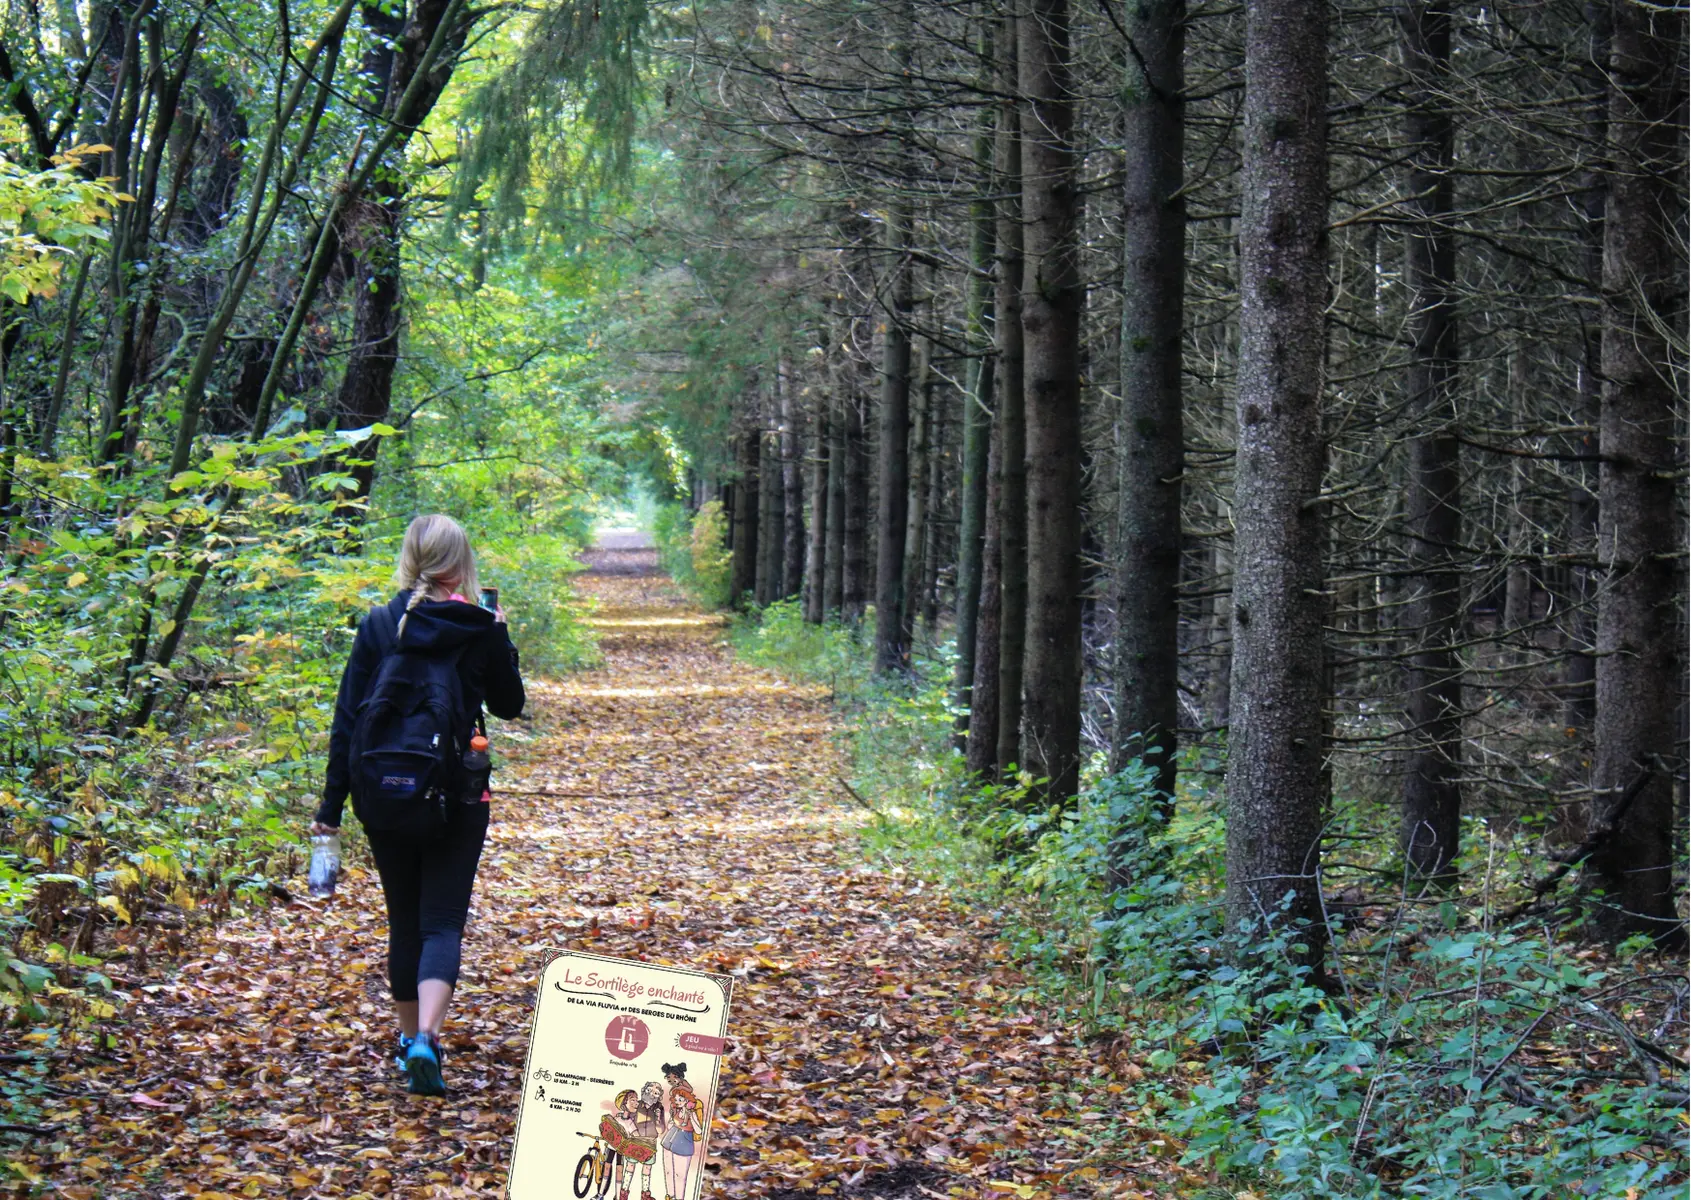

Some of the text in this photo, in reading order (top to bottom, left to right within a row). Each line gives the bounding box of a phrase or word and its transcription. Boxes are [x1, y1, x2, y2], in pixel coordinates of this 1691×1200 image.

[564, 968, 705, 1004] Le Sortilège enchanté
[598, 1002, 619, 1010] FLUVIA
[641, 1009, 665, 1018] BERGES
[676, 1014, 697, 1023] RHÔNE
[555, 1072, 586, 1081] CHAMPAGNE
[551, 1098, 582, 1107] CHAMPAGNE
